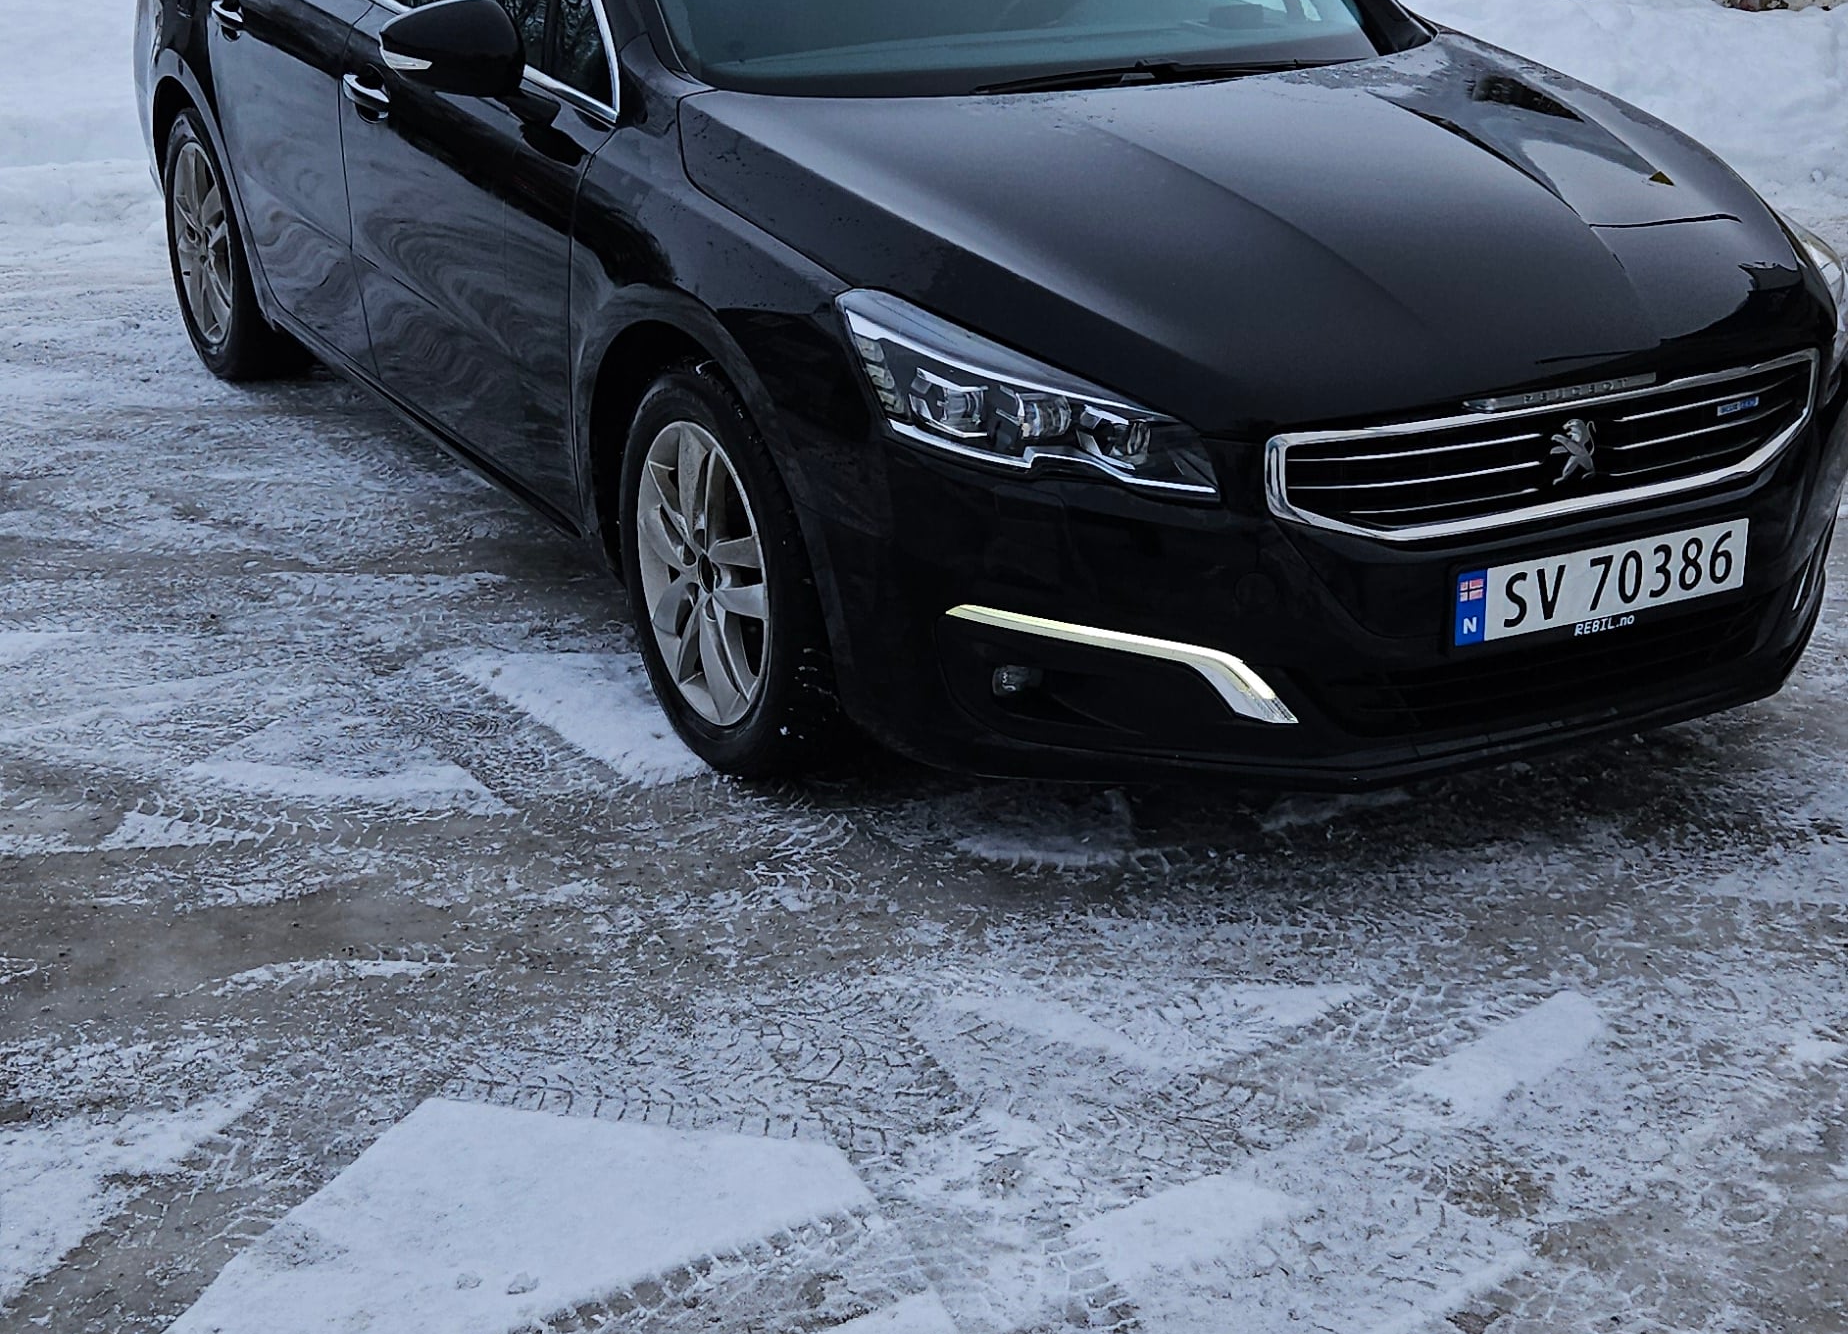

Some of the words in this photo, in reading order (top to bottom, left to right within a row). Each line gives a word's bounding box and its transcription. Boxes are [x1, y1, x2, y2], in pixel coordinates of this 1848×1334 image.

[1503, 564, 1566, 628] SV
[1590, 530, 1733, 611] 70386
[1463, 616, 1477, 634] N
[1574, 615, 1635, 637] REBIL.no
